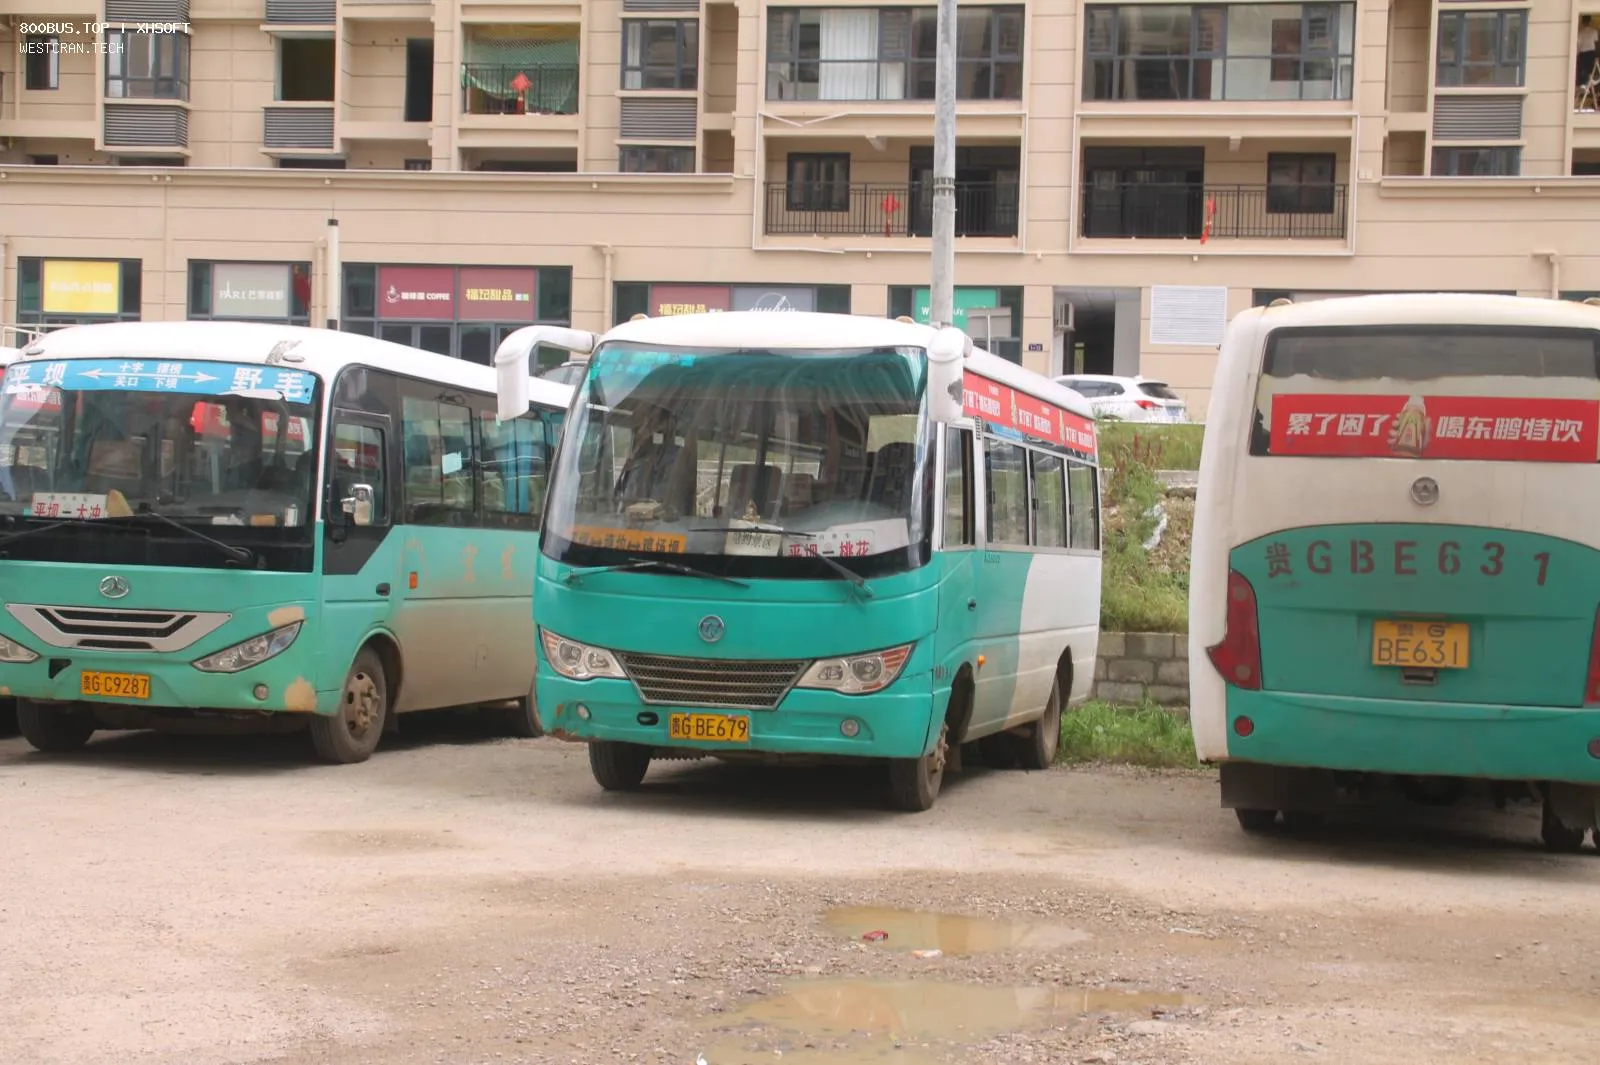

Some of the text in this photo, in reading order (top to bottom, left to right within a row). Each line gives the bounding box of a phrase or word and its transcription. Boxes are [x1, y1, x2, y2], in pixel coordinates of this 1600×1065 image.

[1285, 412, 1584, 442] 累了困了 喝东鹏特饮
[1264, 539, 1552, 587] 贵GBE631
[1377, 638, 1459, 665] BE631
